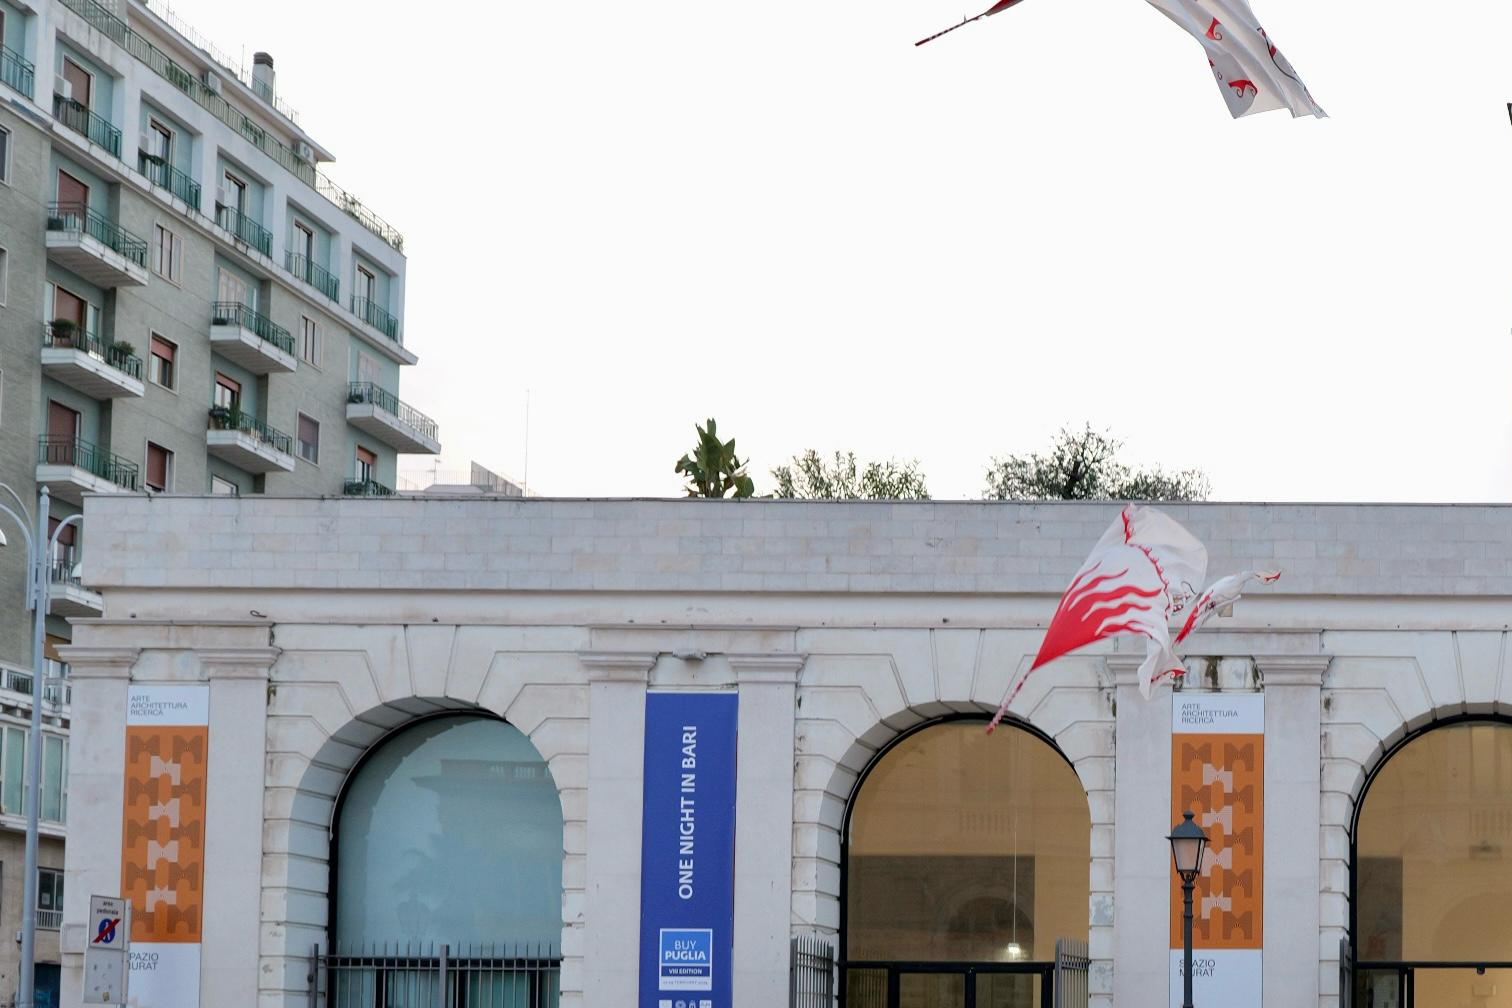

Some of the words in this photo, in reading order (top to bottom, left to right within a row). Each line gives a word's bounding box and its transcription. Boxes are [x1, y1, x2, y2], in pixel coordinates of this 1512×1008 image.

[682, 725, 697, 769] BARI
[681, 773, 696, 793] IN
[679, 797, 695, 855] NIGHT
[679, 858, 694, 900] ONE
[674, 940, 697, 950] BUY
[129, 952, 159, 962] PAZIO
[665, 951, 706, 961] PUGLIA
[1179, 959, 1216, 968] SAZIO
